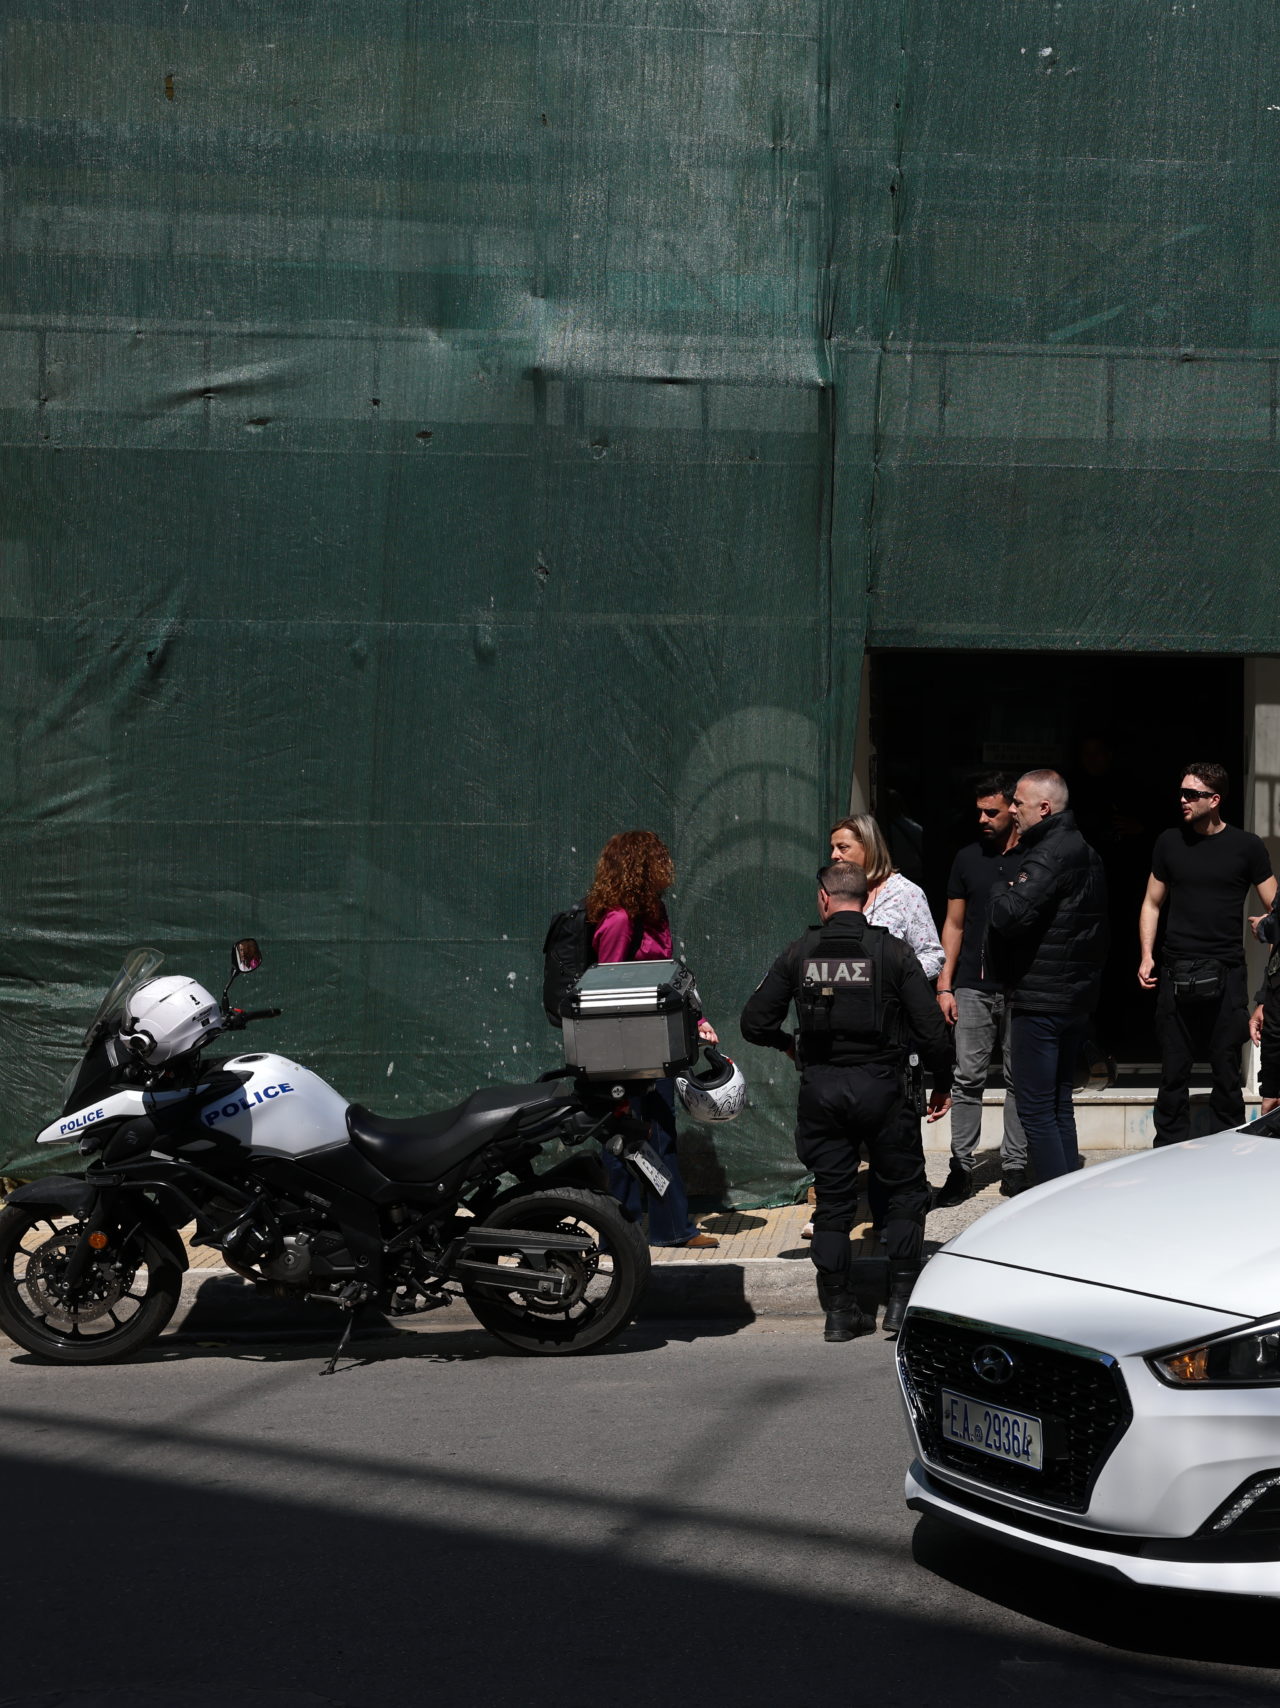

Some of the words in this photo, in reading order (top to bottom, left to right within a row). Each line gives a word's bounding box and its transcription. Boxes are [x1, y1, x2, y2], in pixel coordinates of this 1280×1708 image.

[59, 1108, 105, 1134] POLICE
[204, 1082, 294, 1127] POLICE
[984, 1410, 1031, 1462] 29364
